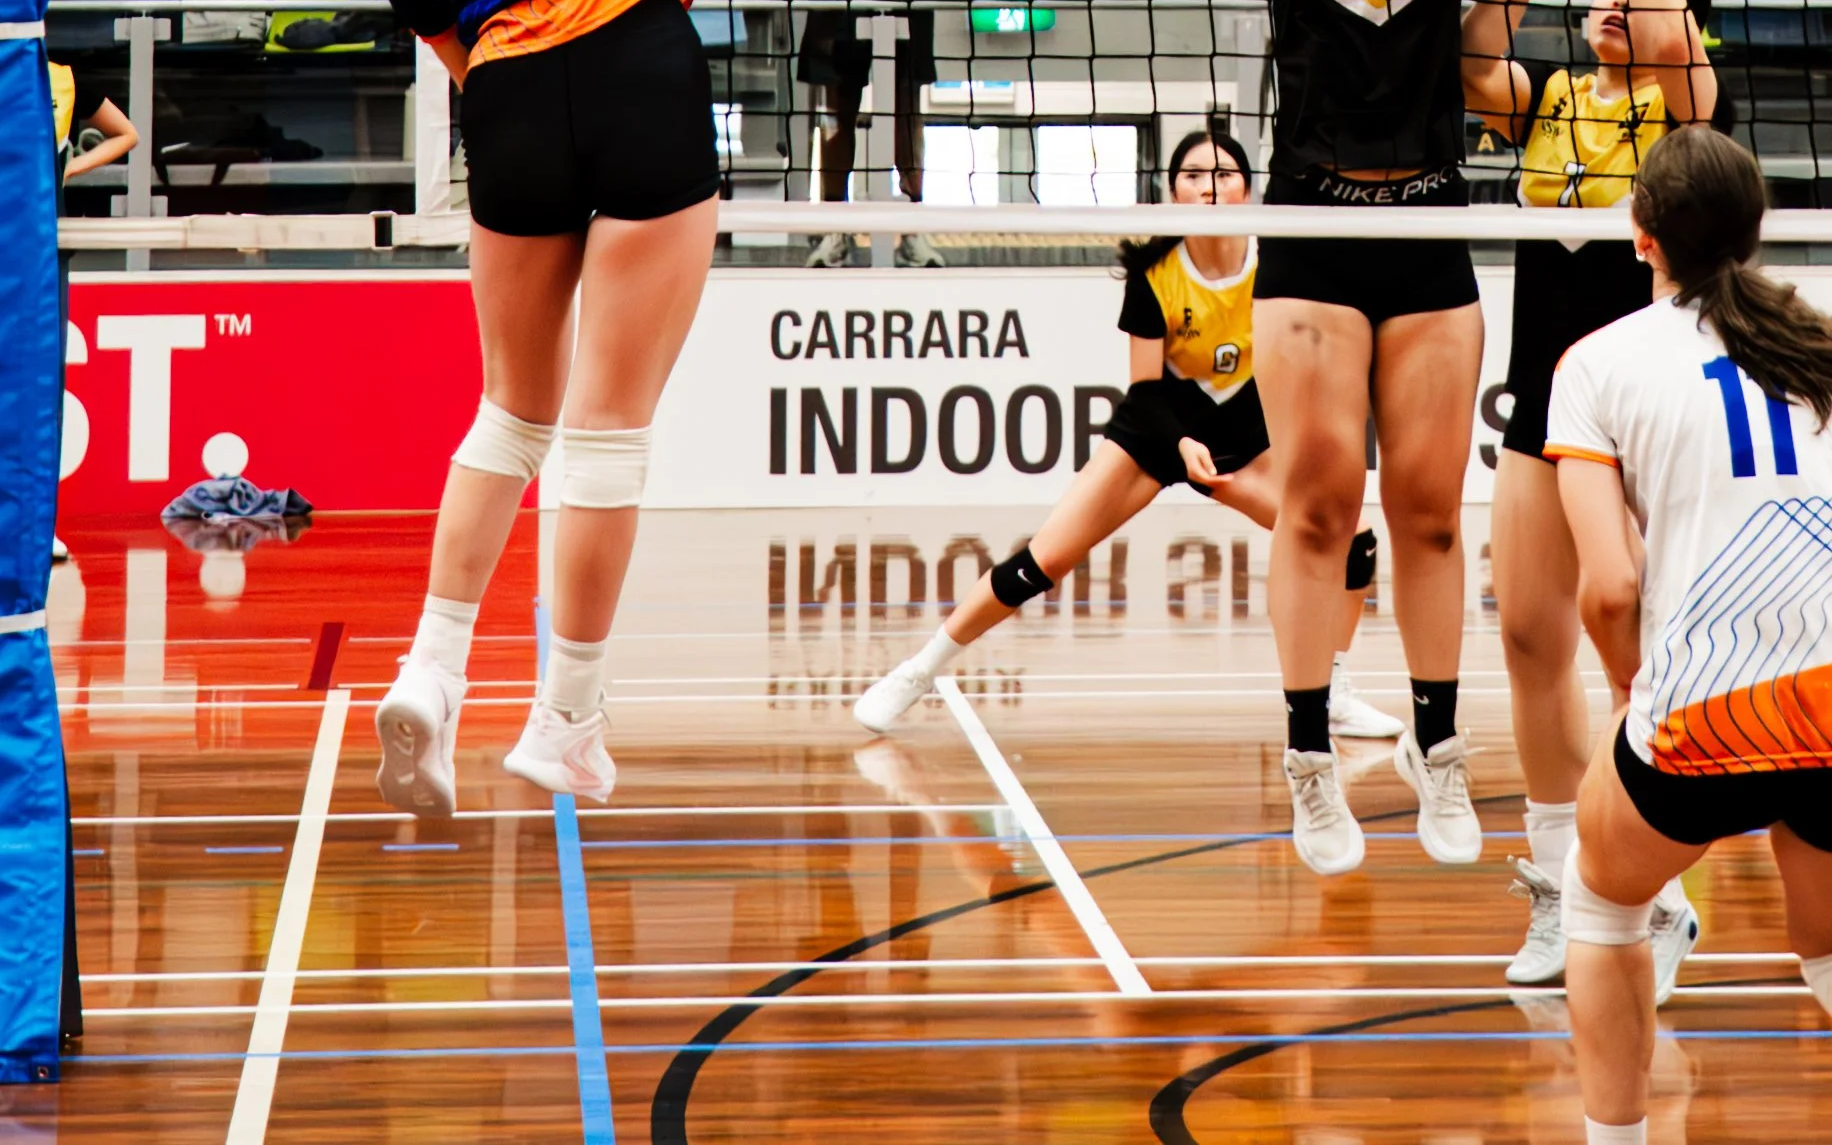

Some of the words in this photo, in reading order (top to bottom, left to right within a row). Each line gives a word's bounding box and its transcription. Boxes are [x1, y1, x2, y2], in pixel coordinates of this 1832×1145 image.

[1477, 132, 1495, 152] A
[1319, 176, 1393, 203] NIKE
[770, 309, 1030, 360] CARRARA
[1702, 355, 1799, 478] 11
